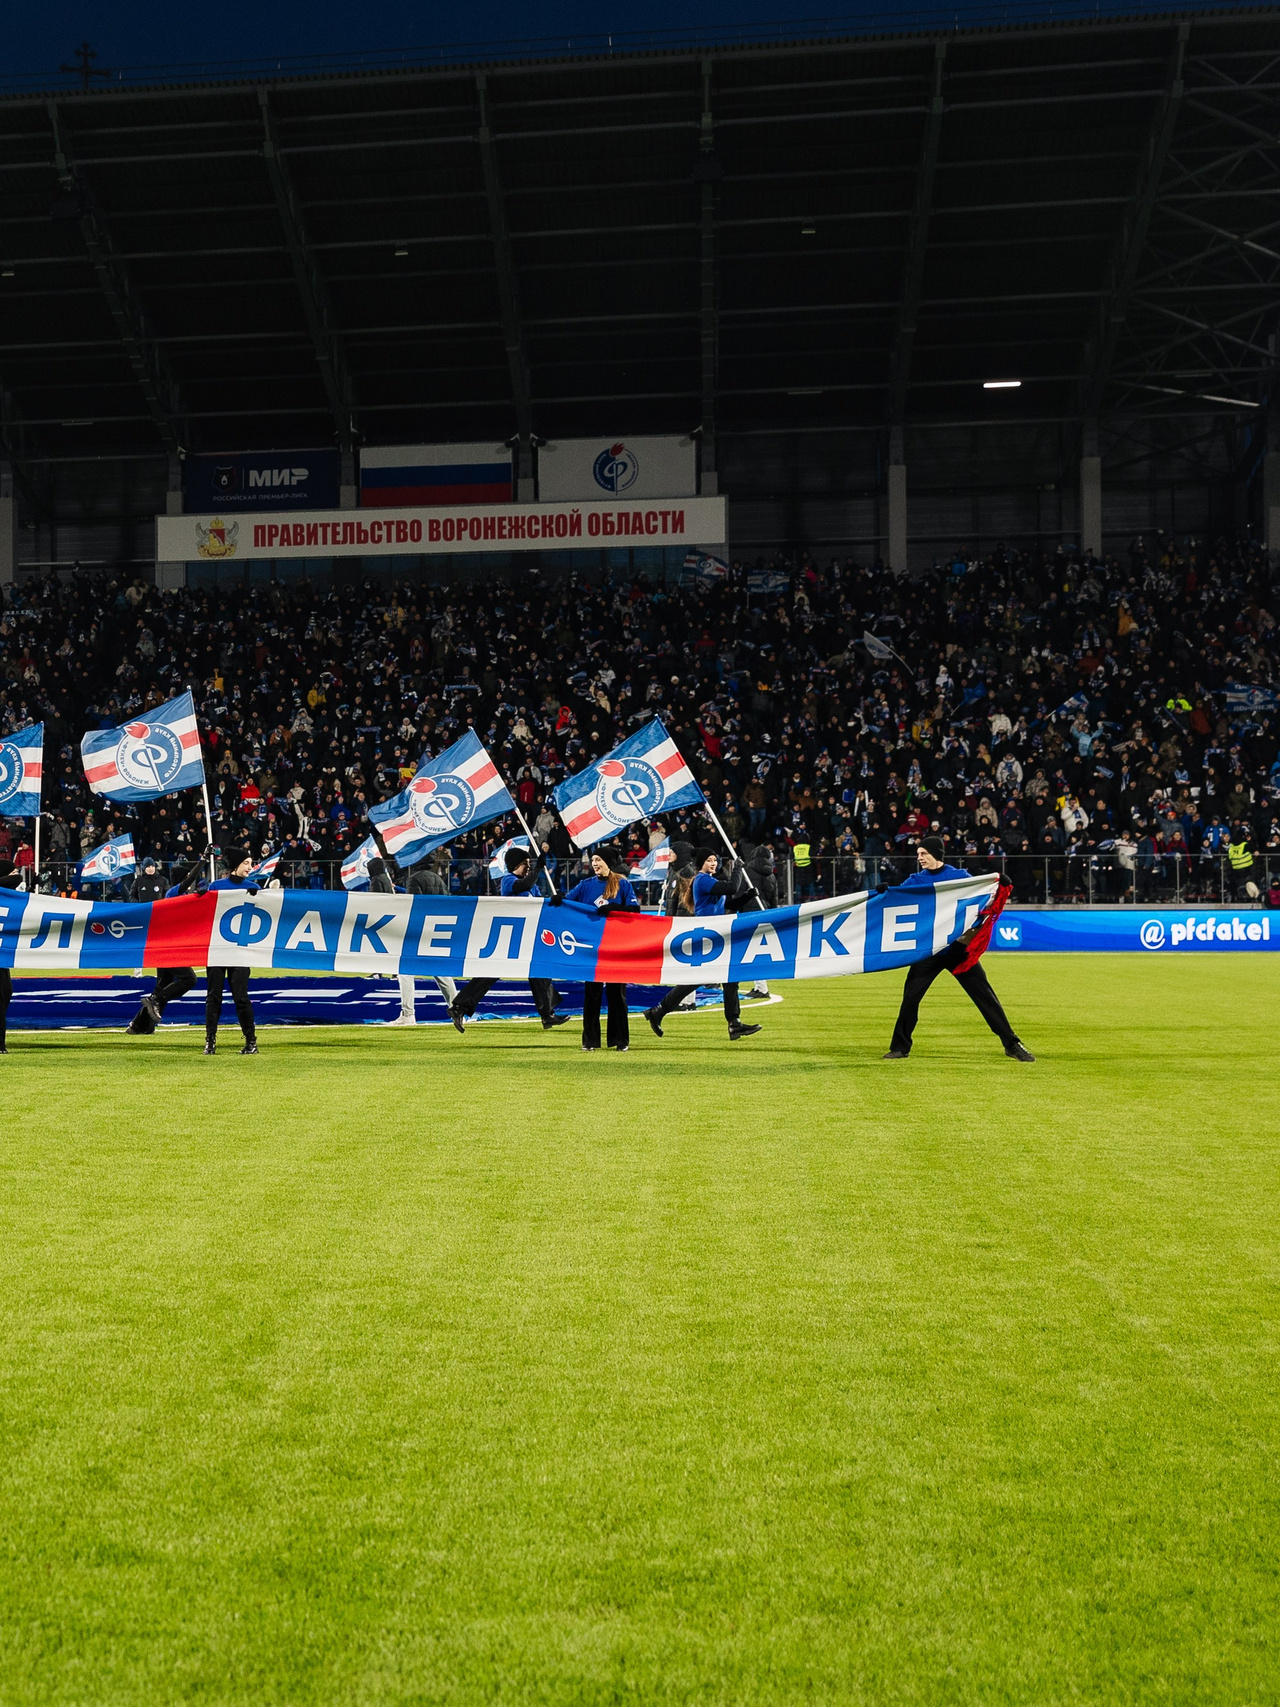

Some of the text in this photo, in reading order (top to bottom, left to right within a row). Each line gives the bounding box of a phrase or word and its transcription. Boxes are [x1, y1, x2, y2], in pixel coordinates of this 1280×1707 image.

[212, 491, 308, 502] РОССИЙСКАЯ ПРЕМЬЕР-ЛИГА
[249, 468, 309, 487] МИР
[253, 508, 685, 548] ПРАВИТЕЛЬСТВО ВОРОНЕЖСКОЙ ОБЛАСТИ
[218, 901, 527, 960] ФАКЕЛ
[669, 893, 992, 967] ФАКЕЛ
